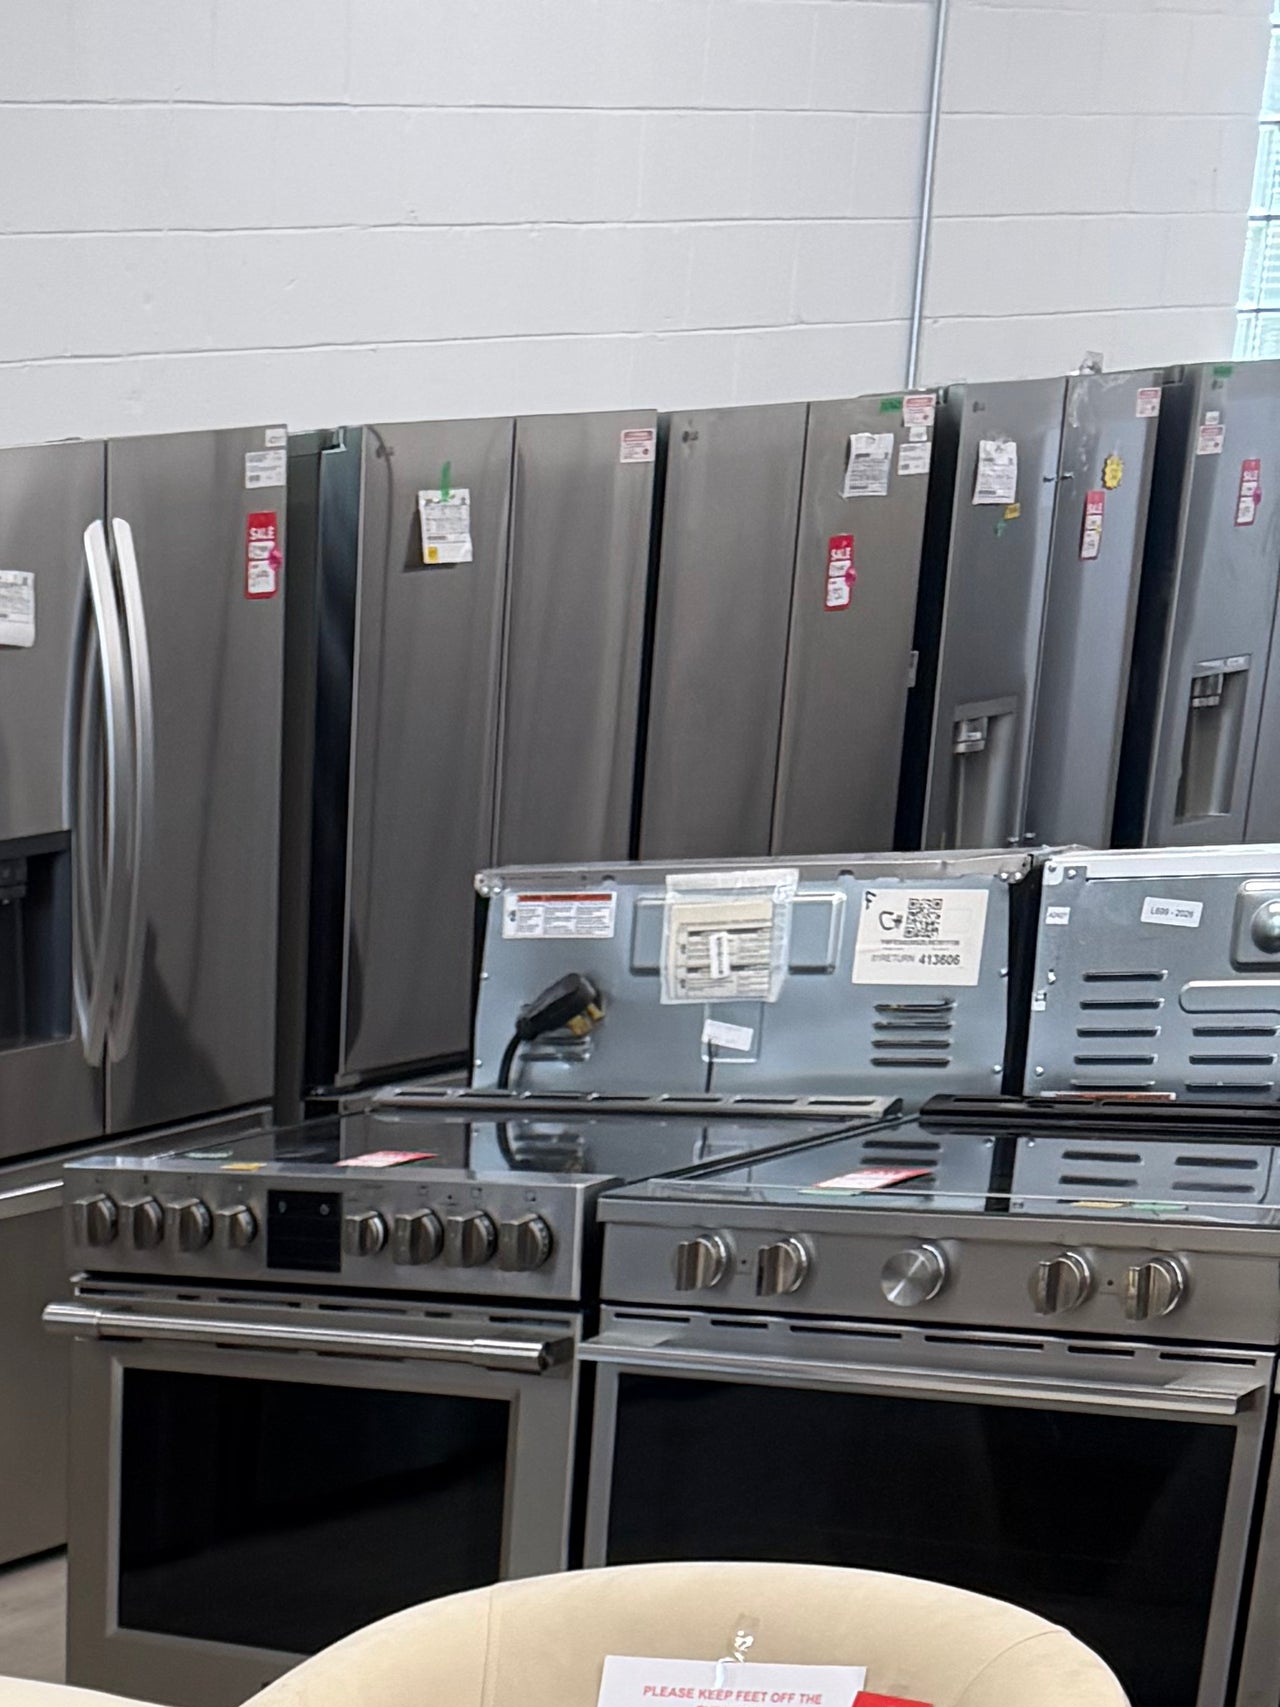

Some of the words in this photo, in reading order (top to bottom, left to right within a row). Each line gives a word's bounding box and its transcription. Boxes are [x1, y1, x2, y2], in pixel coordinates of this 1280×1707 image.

[642, 1685, 695, 1699] PLEASE
[698, 1688, 733, 1701] KEEP
[736, 1690, 768, 1702] FEET
[770, 1692, 795, 1703] OFF
[799, 1693, 822, 1705] THE
